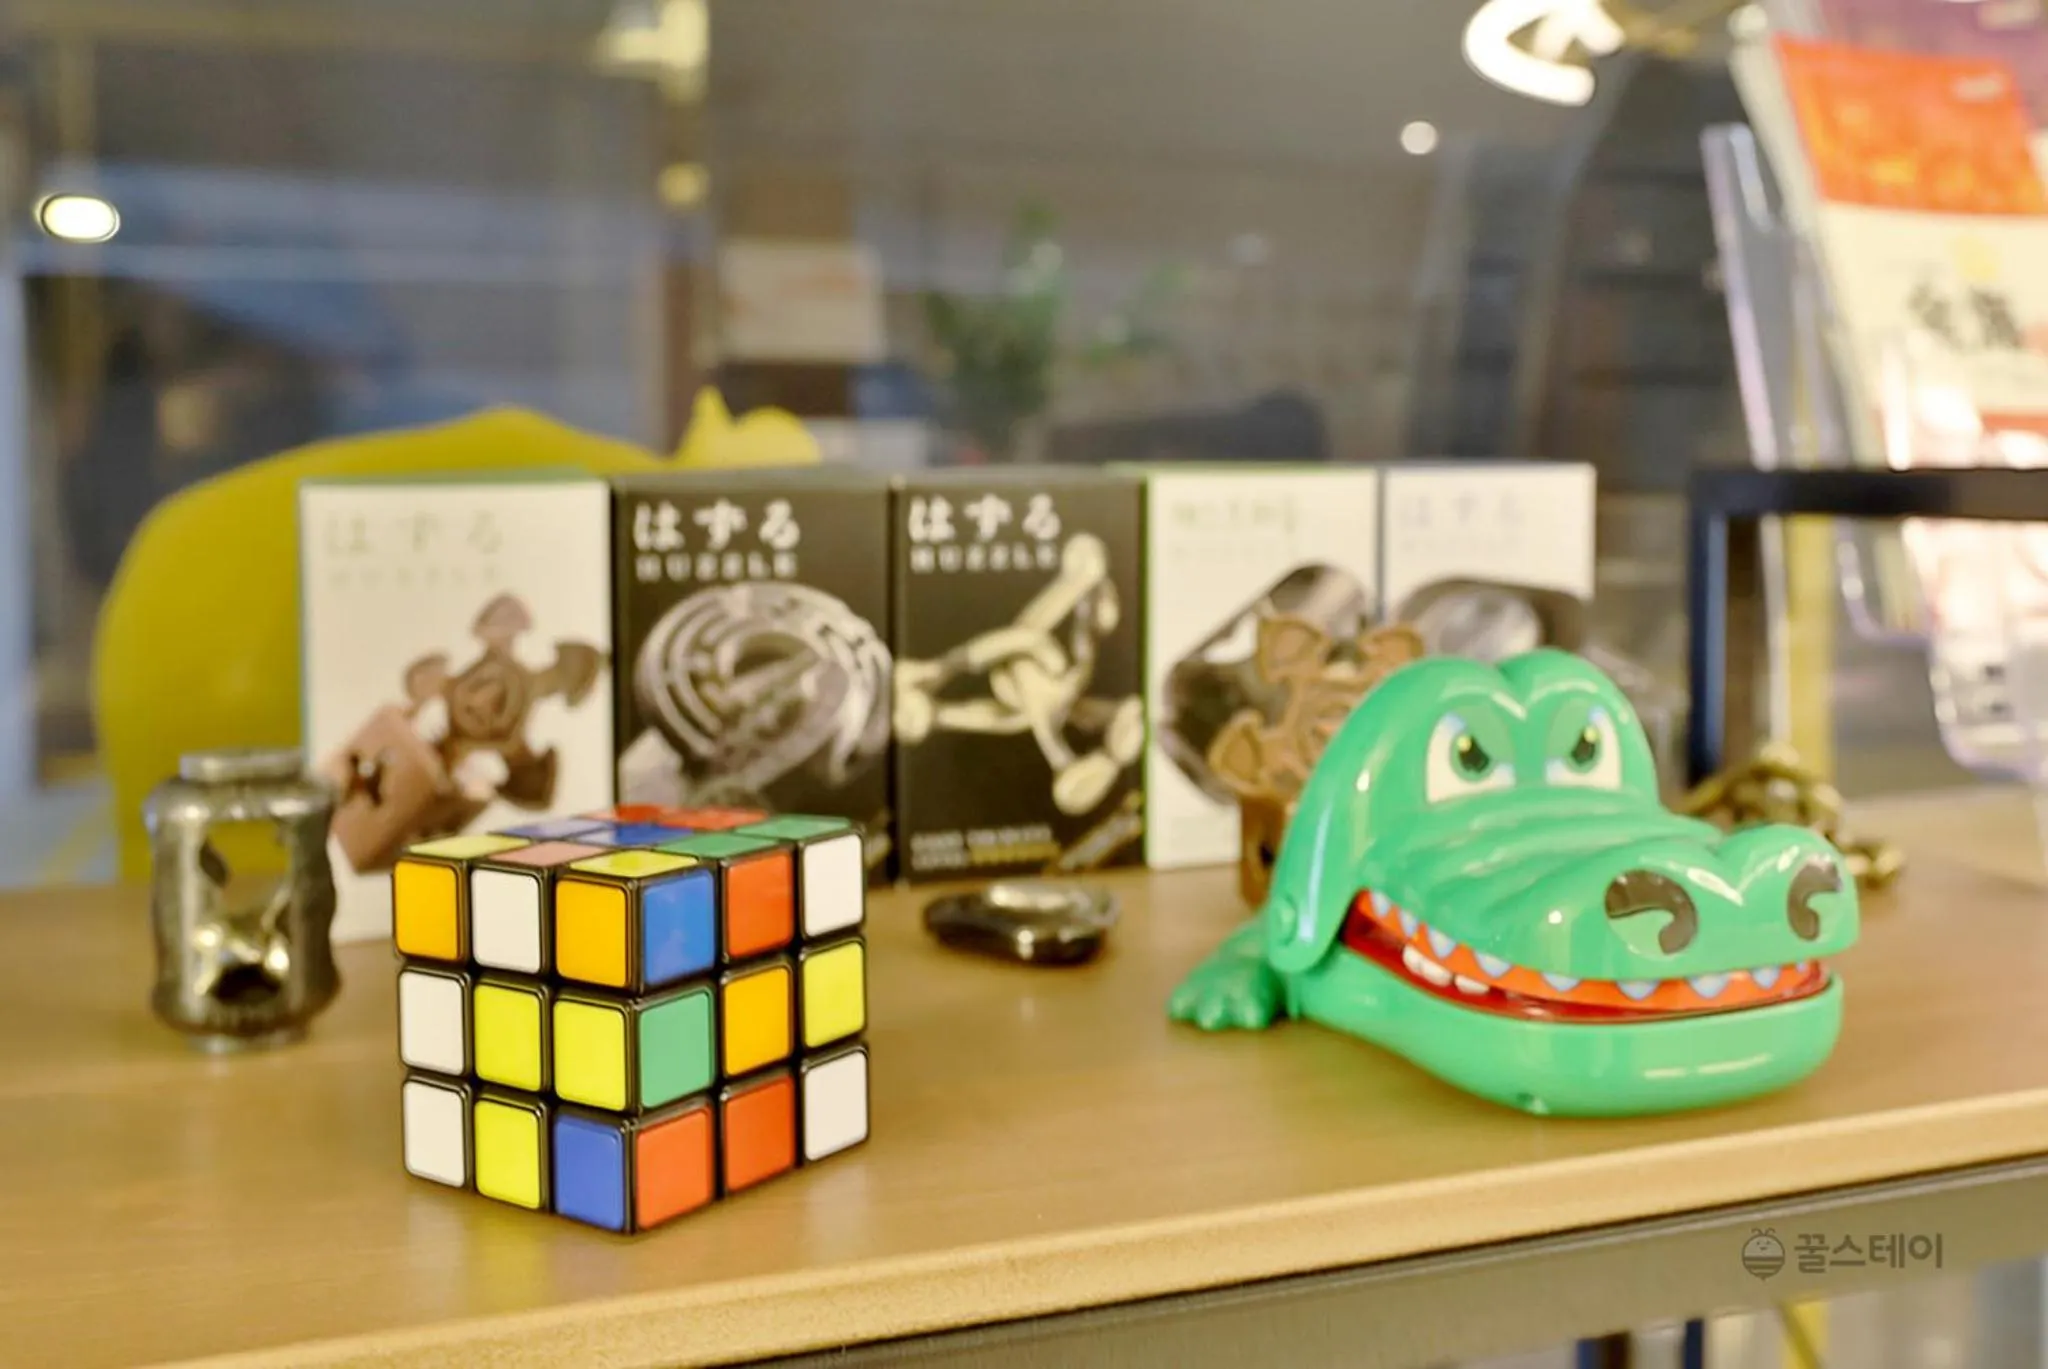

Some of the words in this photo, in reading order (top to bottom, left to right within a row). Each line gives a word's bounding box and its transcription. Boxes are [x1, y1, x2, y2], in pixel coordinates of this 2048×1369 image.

[634, 498, 800, 552] はずる
[908, 493, 1061, 544] はずる
